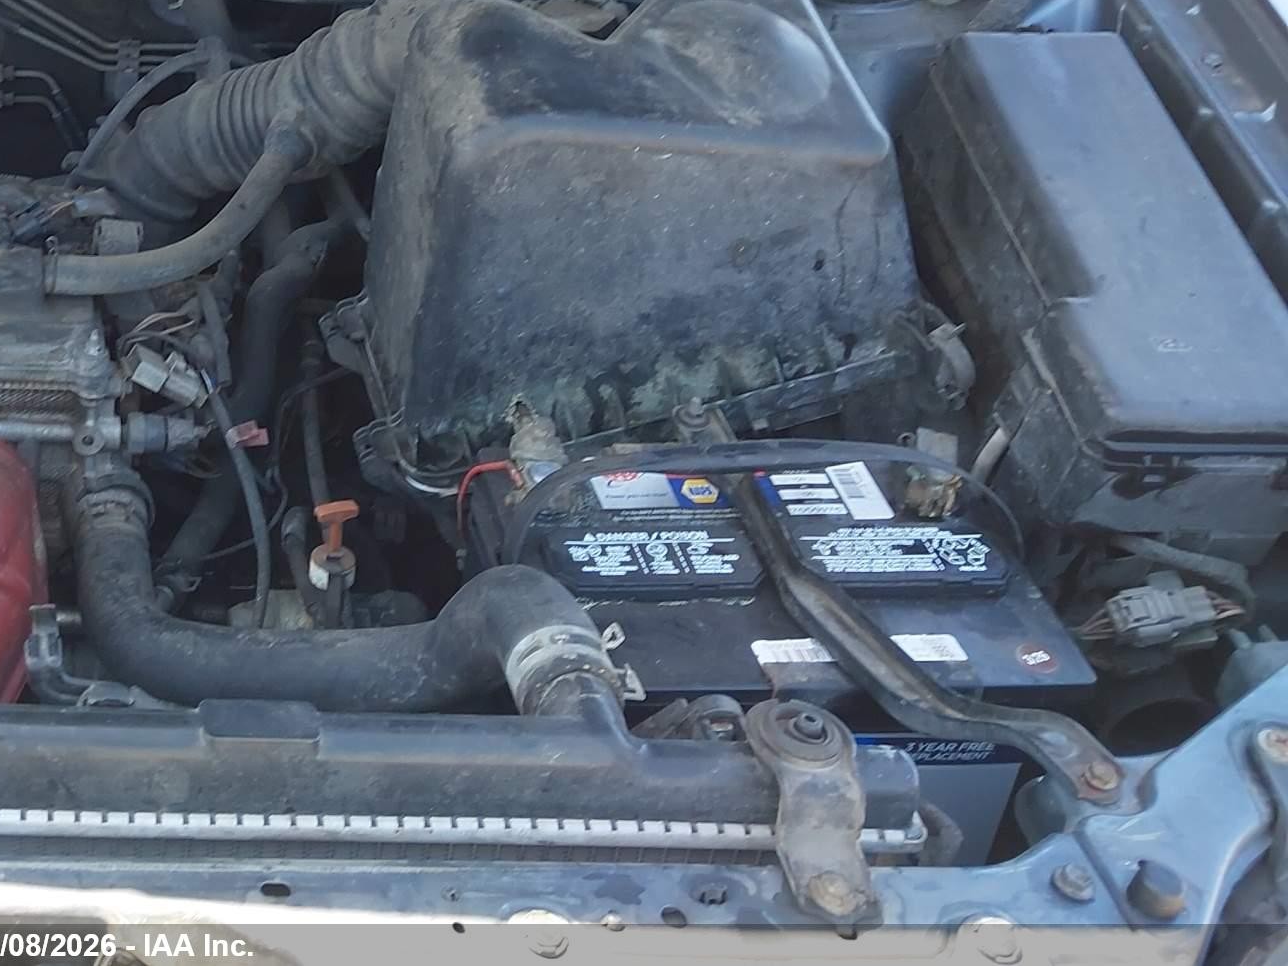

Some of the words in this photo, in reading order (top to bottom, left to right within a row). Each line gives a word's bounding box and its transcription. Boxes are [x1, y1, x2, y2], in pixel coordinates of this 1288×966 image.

[595, 531, 650, 542] DANGER
[917, 742, 958, 752] YEAR
[958, 741, 994, 751] FREE
[912, 751, 991, 762] PLACEMENT
